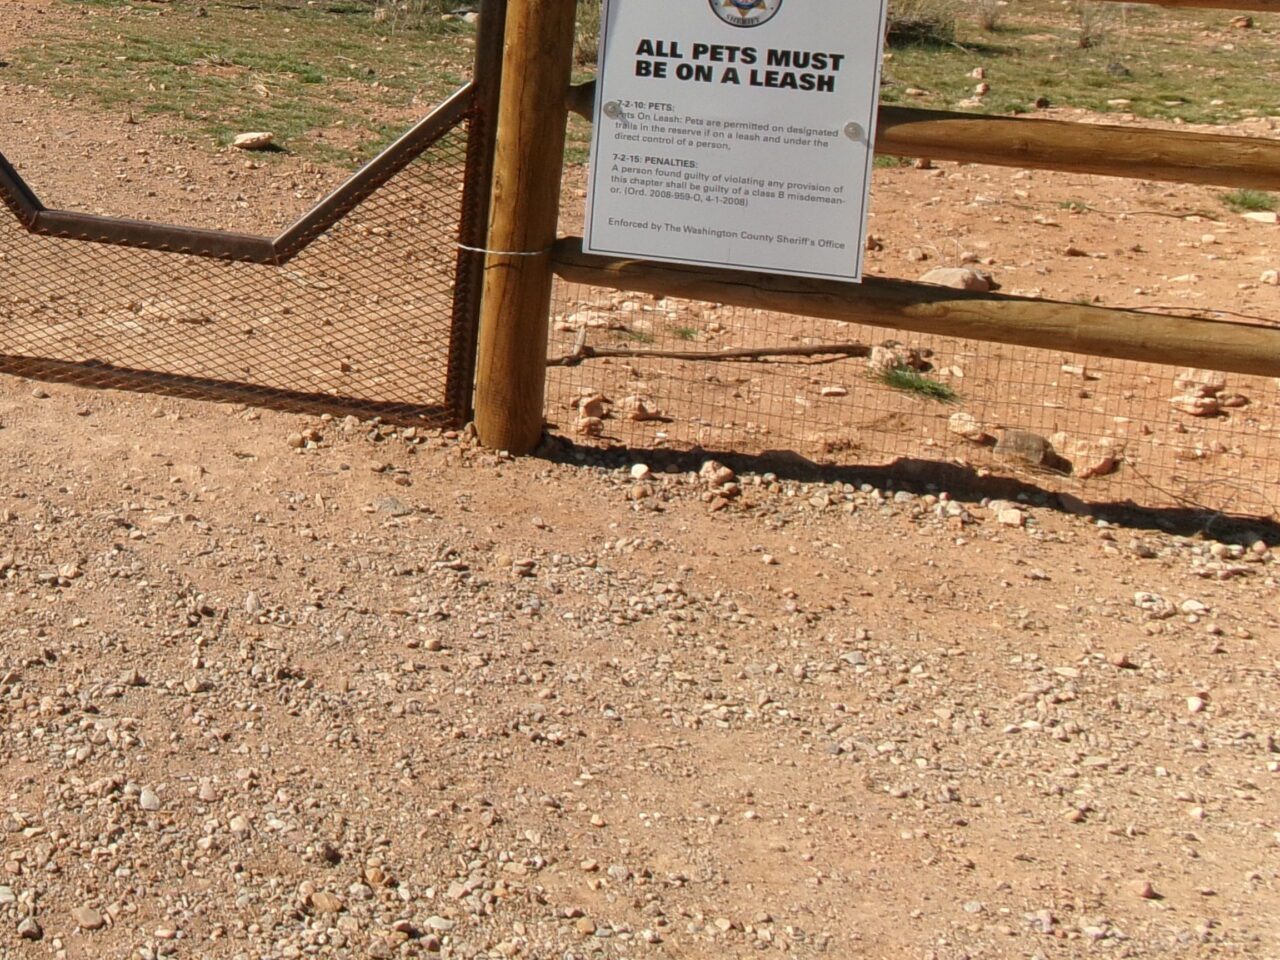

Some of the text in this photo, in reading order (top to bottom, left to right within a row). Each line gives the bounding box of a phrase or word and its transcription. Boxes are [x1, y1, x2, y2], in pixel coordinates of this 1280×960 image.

[636, 39, 845, 71] ALL PETS MUST
[635, 60, 835, 92] BE ON A LEASH
[648, 102, 675, 112] PETS:
[615, 121, 638, 130] trails
[640, 123, 649, 131] in
[651, 124, 665, 133] the
[668, 127, 701, 136] reserve
[704, 129, 711, 137] if
[735, 131, 760, 142] leash
[763, 135, 781, 143] and
[783, 137, 811, 146] under
[814, 139, 828, 148] the
[638, 112, 651, 121] On
[653, 114, 682, 123] Leash:
[685, 116, 704, 125] Pets
[724, 121, 769, 131] permitted
[772, 124, 784, 132] on
[786, 125, 839, 137] designated
[614, 132, 640, 141] direct
[642, 136, 674, 145] control
[676, 137, 686, 145] of
[612, 153, 698, 168] 7-2-15: PENALTIES:
[611, 163, 844, 193] A person found guilty of violating any provision of
[611, 175, 628, 184] this
[629, 177, 664, 187] chapter
[665, 179, 687, 189] shall
[689, 182, 701, 191] be
[703, 184, 729, 194] guilty
[732, 186, 742, 195] of
[752, 189, 775, 198] class
[778, 190, 785, 199] B
[787, 192, 846, 204] misdemean-
[624, 186, 646, 196] (Ord.
[608, 217, 845, 250] Enforced by The Washington County Sheriff's Office
